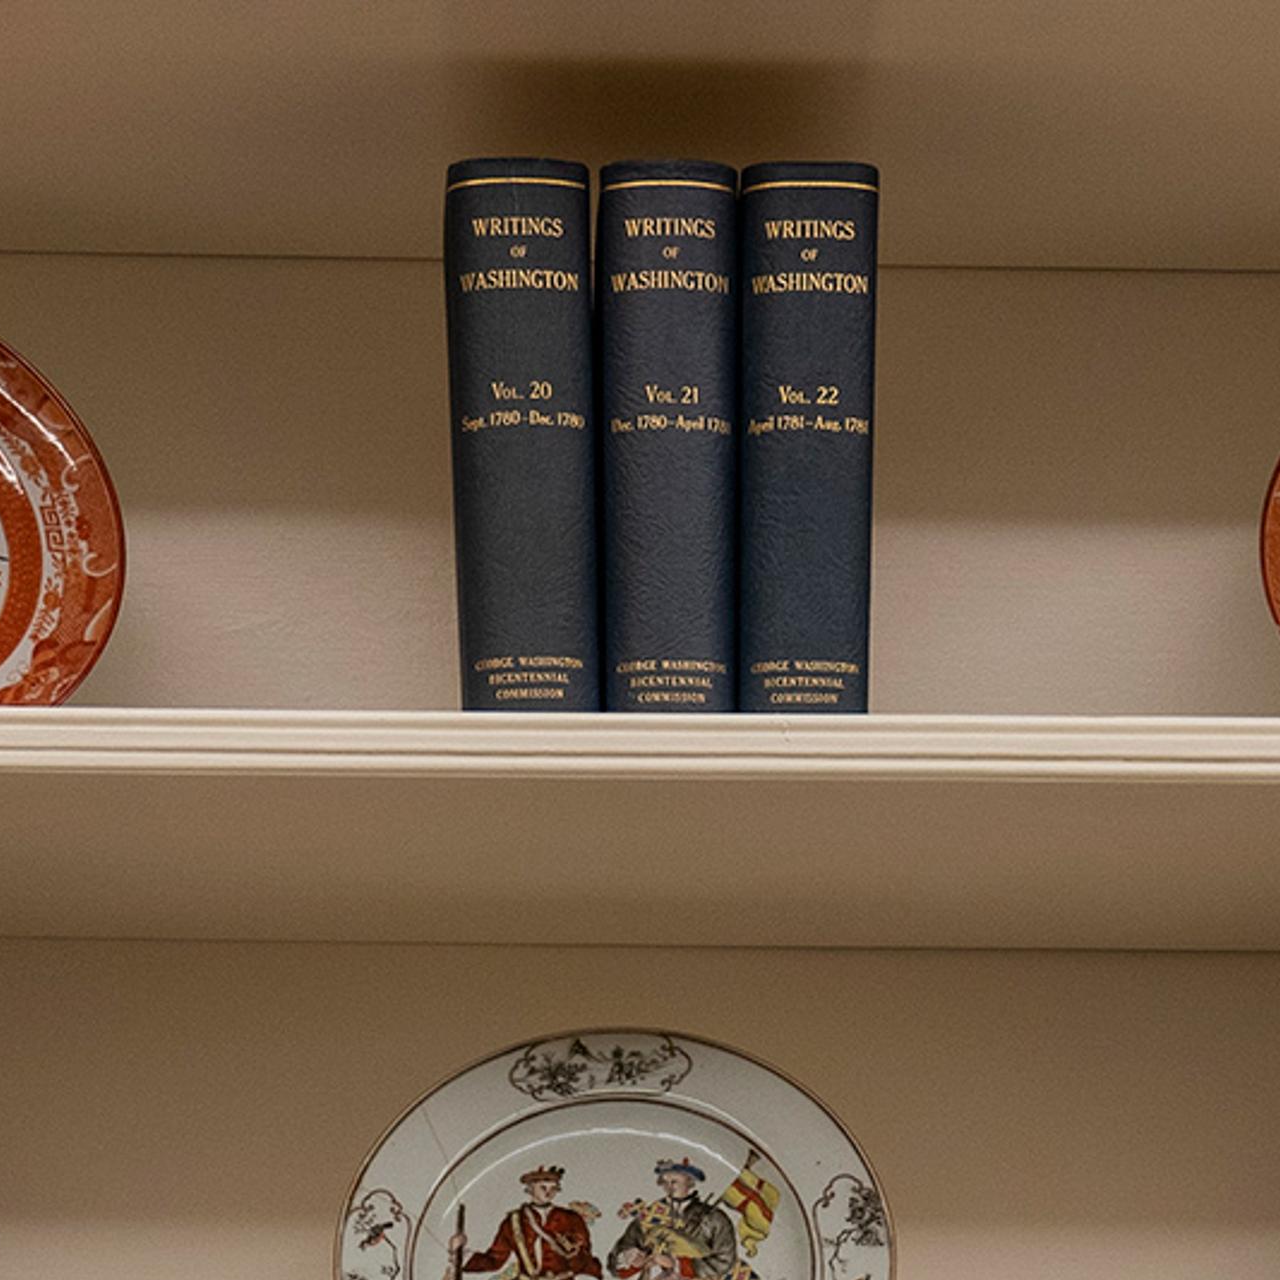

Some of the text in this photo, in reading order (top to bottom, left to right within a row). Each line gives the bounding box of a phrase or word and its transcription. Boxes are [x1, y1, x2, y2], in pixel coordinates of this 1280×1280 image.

[471, 216, 564, 238] WRITINGS
[624, 217, 716, 239] WRITINGS
[764, 219, 856, 241] WRITINGS
[509, 245, 527, 258] OF
[662, 246, 680, 259] OF
[800, 248, 818, 262] OF
[462, 268, 579, 291] WASHINGTON
[611, 270, 729, 294] WASHINGTON
[752, 272, 868, 295] WASHINGTON
[529, 380, 553, 400] 20
[680, 385, 699, 404] 21
[816, 385, 839, 406] 22
